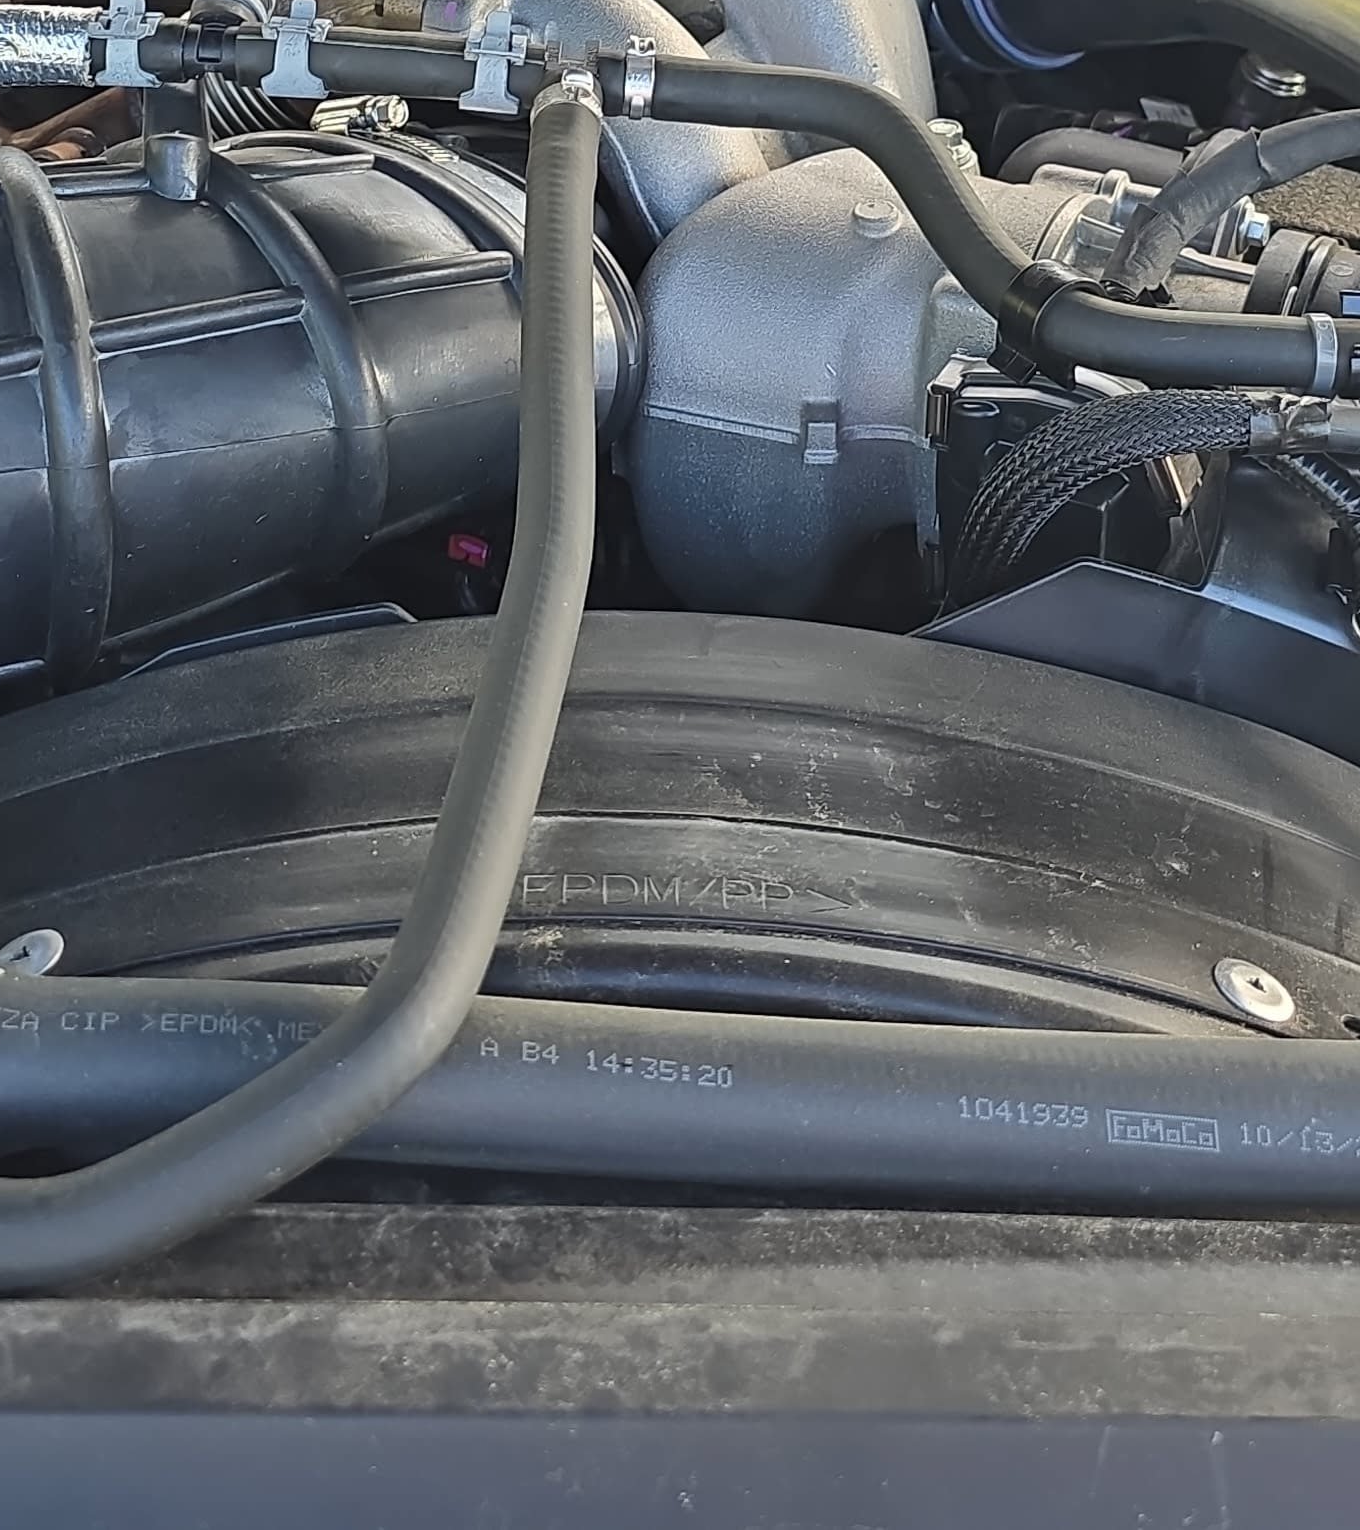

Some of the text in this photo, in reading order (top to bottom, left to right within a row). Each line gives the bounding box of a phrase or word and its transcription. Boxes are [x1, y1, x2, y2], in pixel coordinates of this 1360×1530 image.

[61, 1010, 120, 1031] CIP
[276, 1020, 326, 1041] ME
[522, 1040, 560, 1065] B4
[586, 1049, 733, 1089] 14:35:20
[958, 1094, 1090, 1129] 1041939
[1109, 1112, 1218, 1150] FoMoCo
